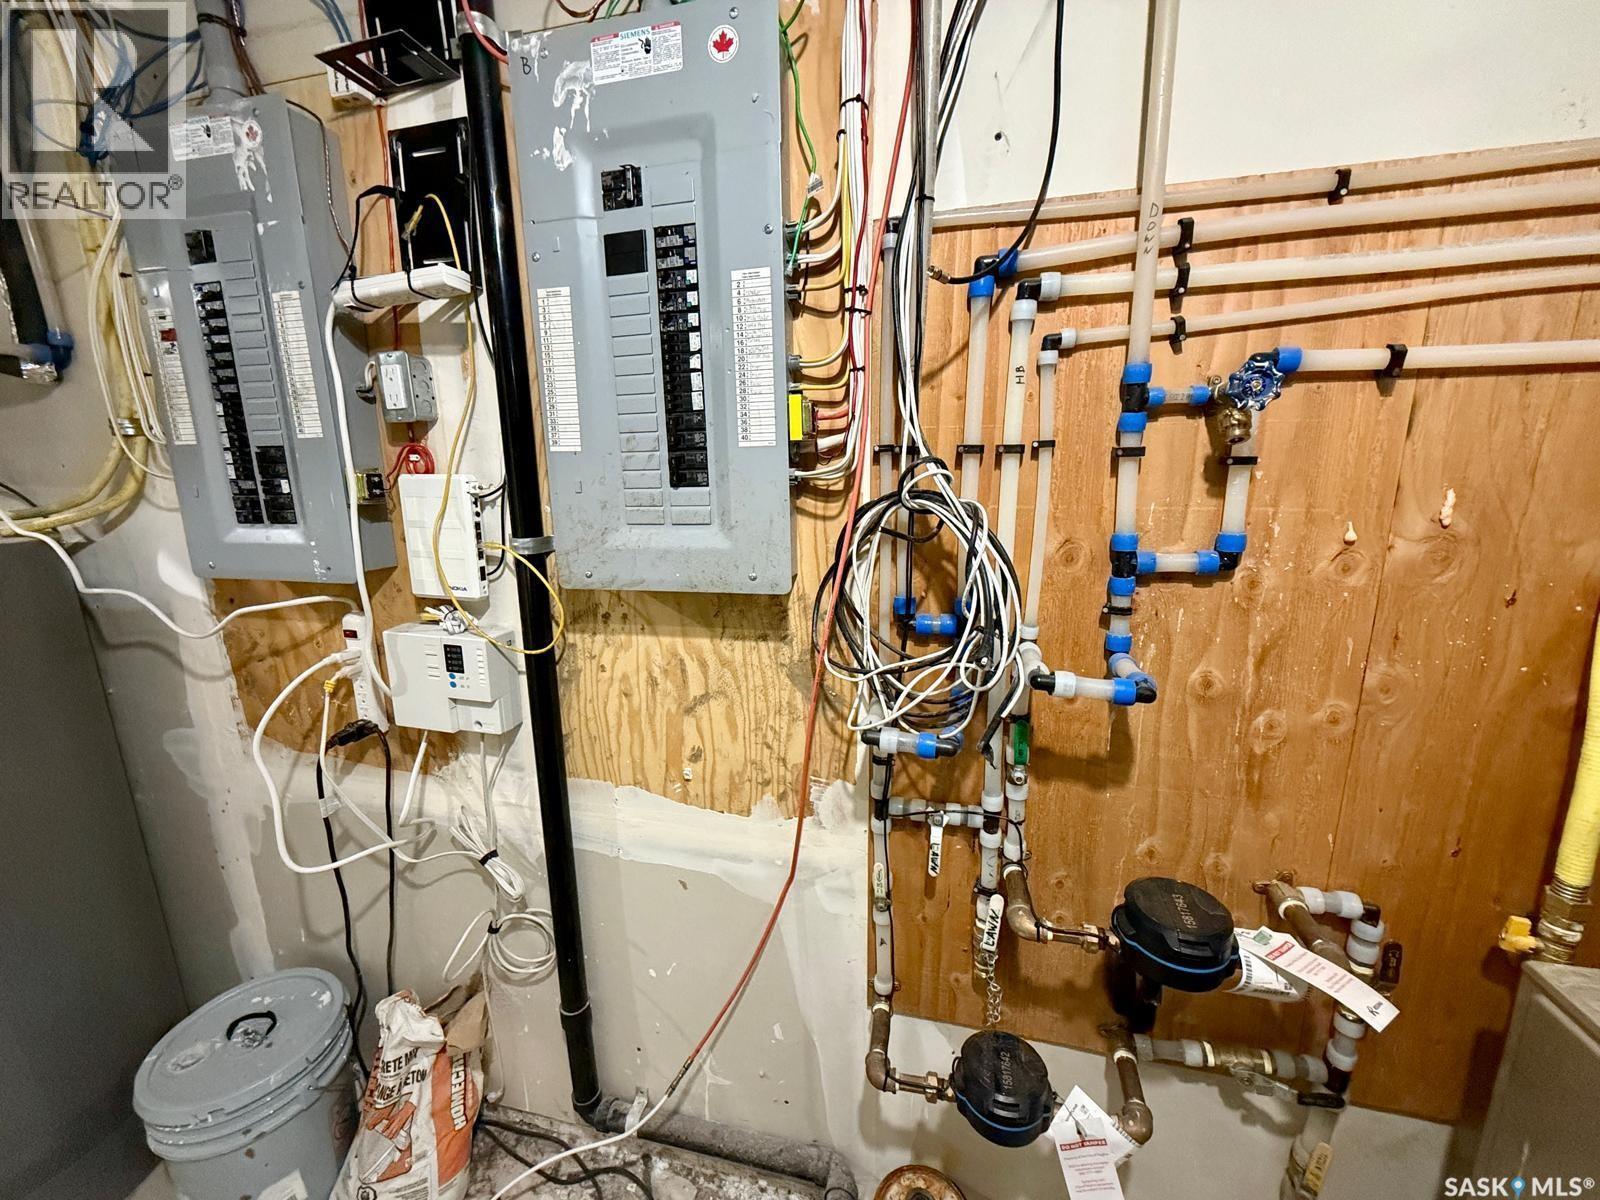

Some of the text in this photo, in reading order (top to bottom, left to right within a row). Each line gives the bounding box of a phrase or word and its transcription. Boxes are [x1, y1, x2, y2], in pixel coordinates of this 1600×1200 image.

[620, 28, 650, 40] SIEMENS
[520, 56, 532, 75] B
[1144, 202, 1159, 254] DOWN
[1015, 366, 1025, 384] HB
[930, 843, 940, 874] LAWN
[1172, 894, 1198, 928] 15817643
[984, 908, 1000, 946] LAWN
[380, 1056, 402, 1074] RETE
